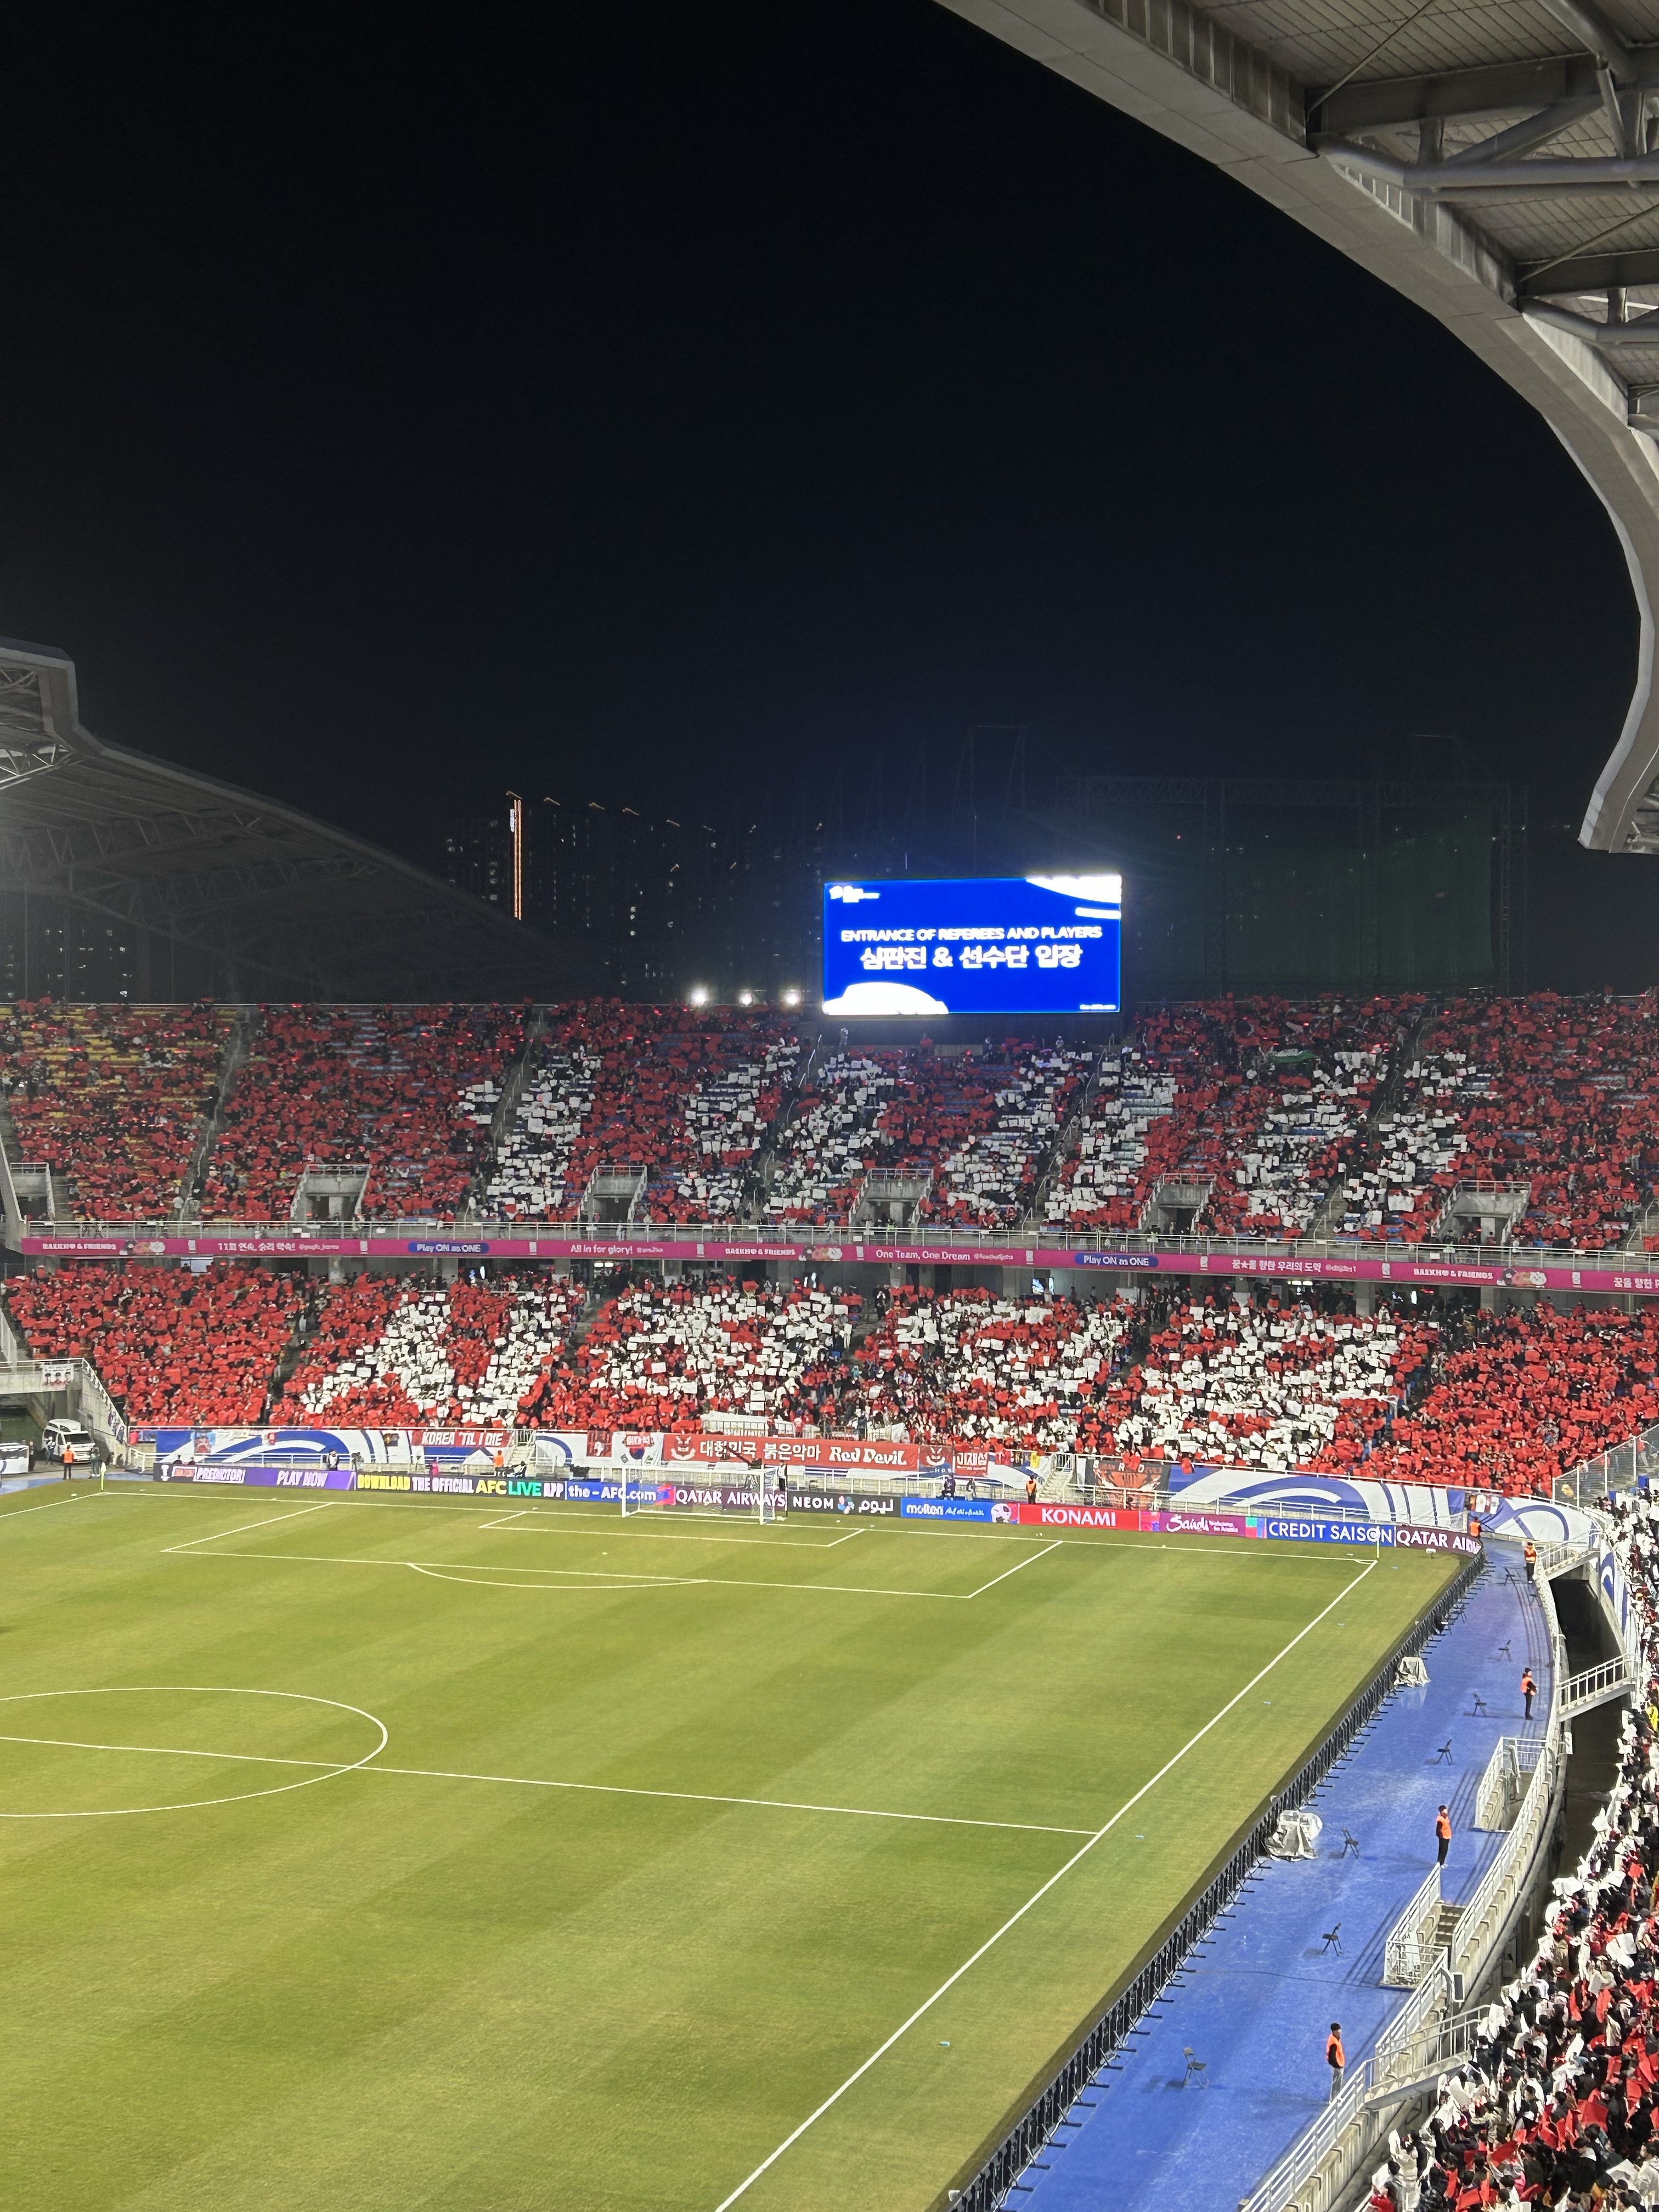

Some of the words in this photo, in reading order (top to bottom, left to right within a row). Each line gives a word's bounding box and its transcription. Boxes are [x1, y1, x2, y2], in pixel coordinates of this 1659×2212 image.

[841, 929, 915, 942] ENTRANCE
[916, 928, 936, 941] OF
[938, 928, 1005, 940] REFEREES
[1007, 927, 1039, 940] AND
[1041, 926, 1103, 939] PLAYERS
[860, 945, 927, 970] 심판진
[933, 946, 953, 968] &
[959, 945, 1030, 969] 선수단
[1035, 944, 1083, 968] 입장
[416, 1244, 434, 1253] Play
[435, 1244, 450, 1252] ON
[461, 1244, 481, 1252] ONE
[571, 1244, 582, 1252] All
[594, 1245, 606, 1253] for
[608, 1245, 633, 1255] glory!
[876, 1250, 893, 1259] One
[895, 1250, 920, 1260] Team,
[922, 1251, 940, 1260] One
[942, 1251, 970, 1261] Dream
[1084, 1255, 1101, 1266] Play
[1103, 1256, 1117, 1265] ON
[1129, 1257, 1149, 1266] ONE
[1277, 1261, 1303, 1272] 우리의
[422, 1431, 455, 1446] KOREA
[478, 1431, 484, 1446] I
[484, 1431, 504, 1447] DIE
[700, 1440, 757, 1458] 대한민국
[763, 1442, 821, 1461] 붉은악마
[829, 1446, 861, 1463] Red
[197, 1467, 243, 1482] PREDICTOR
[276, 1470, 302, 1487] PLAY
[302, 1472, 328, 1488] NOW
[357, 1474, 410, 1491] DOWNLOAD
[412, 1476, 431, 1492] THE
[432, 1478, 475, 1494] OFFICIAL
[476, 1479, 507, 1495] AFC
[508, 1481, 542, 1497] LIVE
[543, 1482, 564, 1498] APP
[675, 1489, 723, 1506] QATAR
[727, 1492, 786, 1508] AIRWAYS
[793, 1496, 833, 1509] NEOM
[1041, 1508, 1116, 1527] KONAMI
[1268, 1521, 1327, 1540] CREDIT
[1330, 1524, 1392, 1544] SAISON
[1397, 1530, 1448, 1547] QATAR
